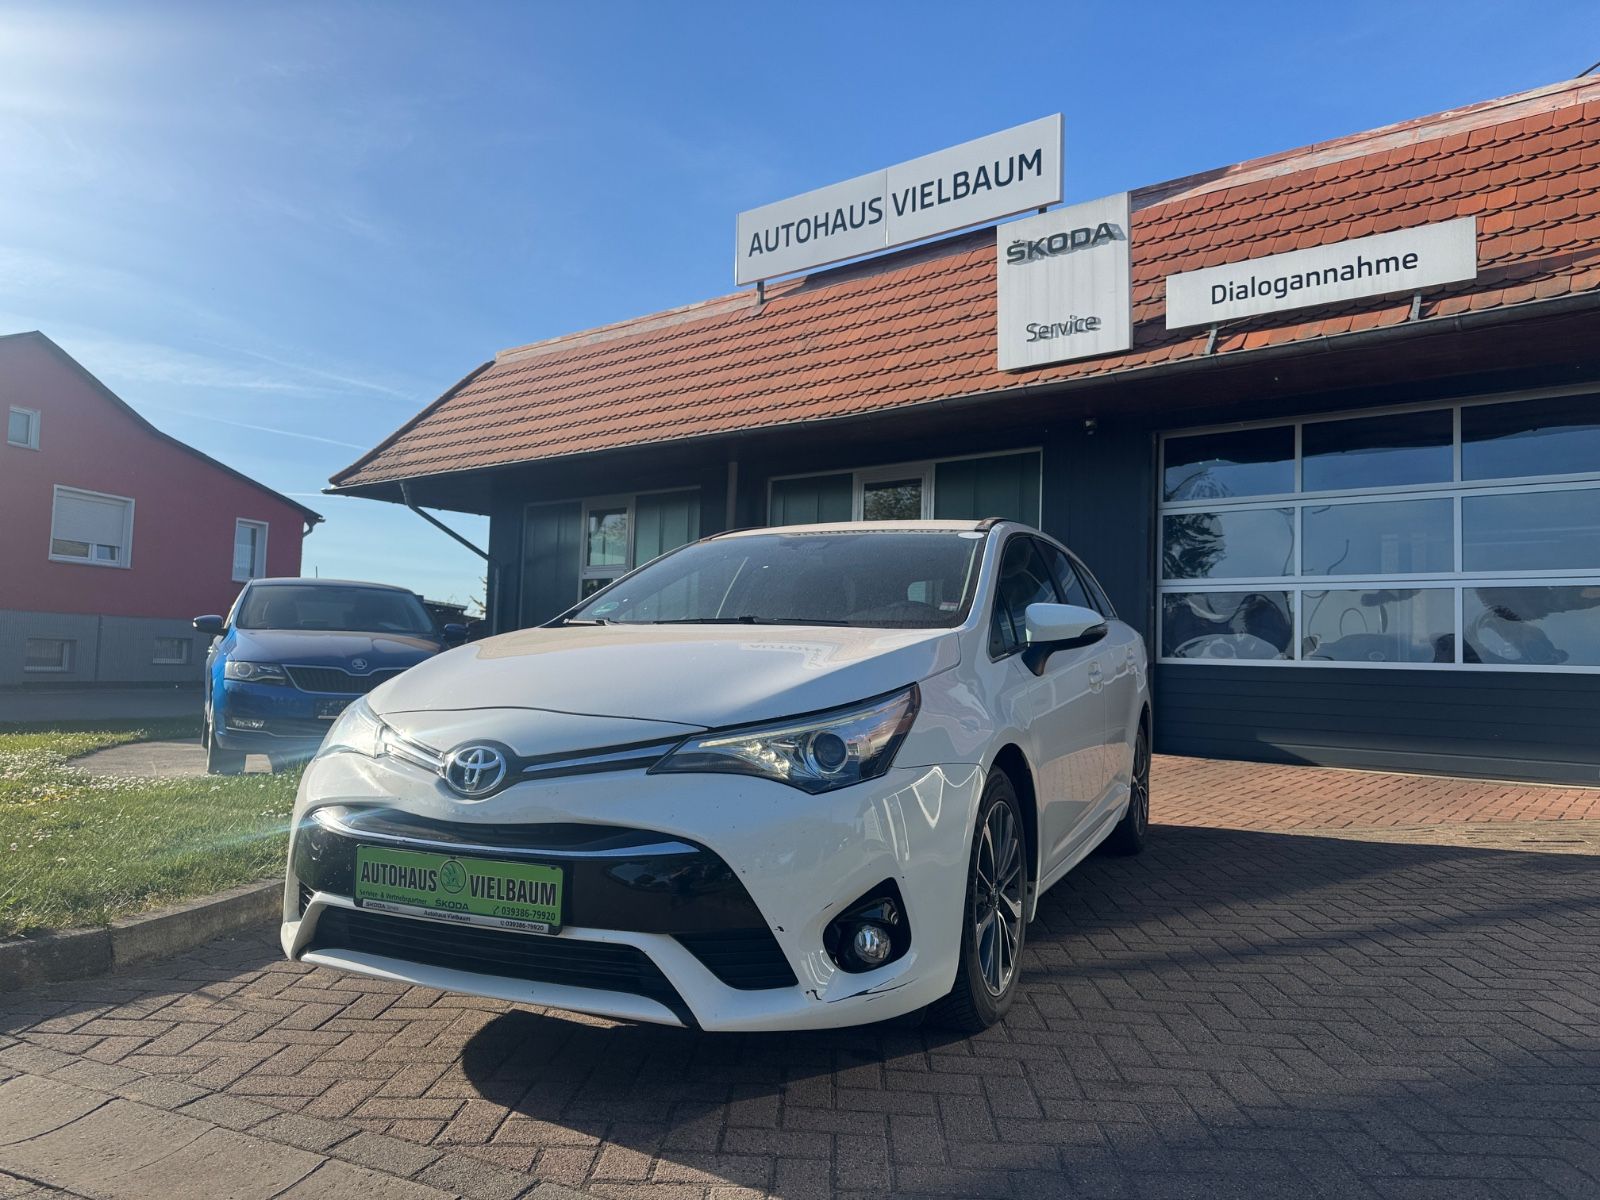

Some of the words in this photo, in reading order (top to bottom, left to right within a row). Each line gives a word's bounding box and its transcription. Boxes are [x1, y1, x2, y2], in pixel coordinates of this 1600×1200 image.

[748, 196, 883, 257] AUTOHAUS
[891, 148, 1042, 217] VIELBAUM
[1006, 222, 1117, 264] ŠKODA
[1211, 252, 1419, 306] Dialogannahme
[1025, 314, 1099, 342] Service
[360, 861, 438, 892] AUTOHAUS
[470, 874, 557, 907] VIELBAUM
[435, 897, 469, 911] ŠKODA
[501, 906, 556, 921] 039386-79920
